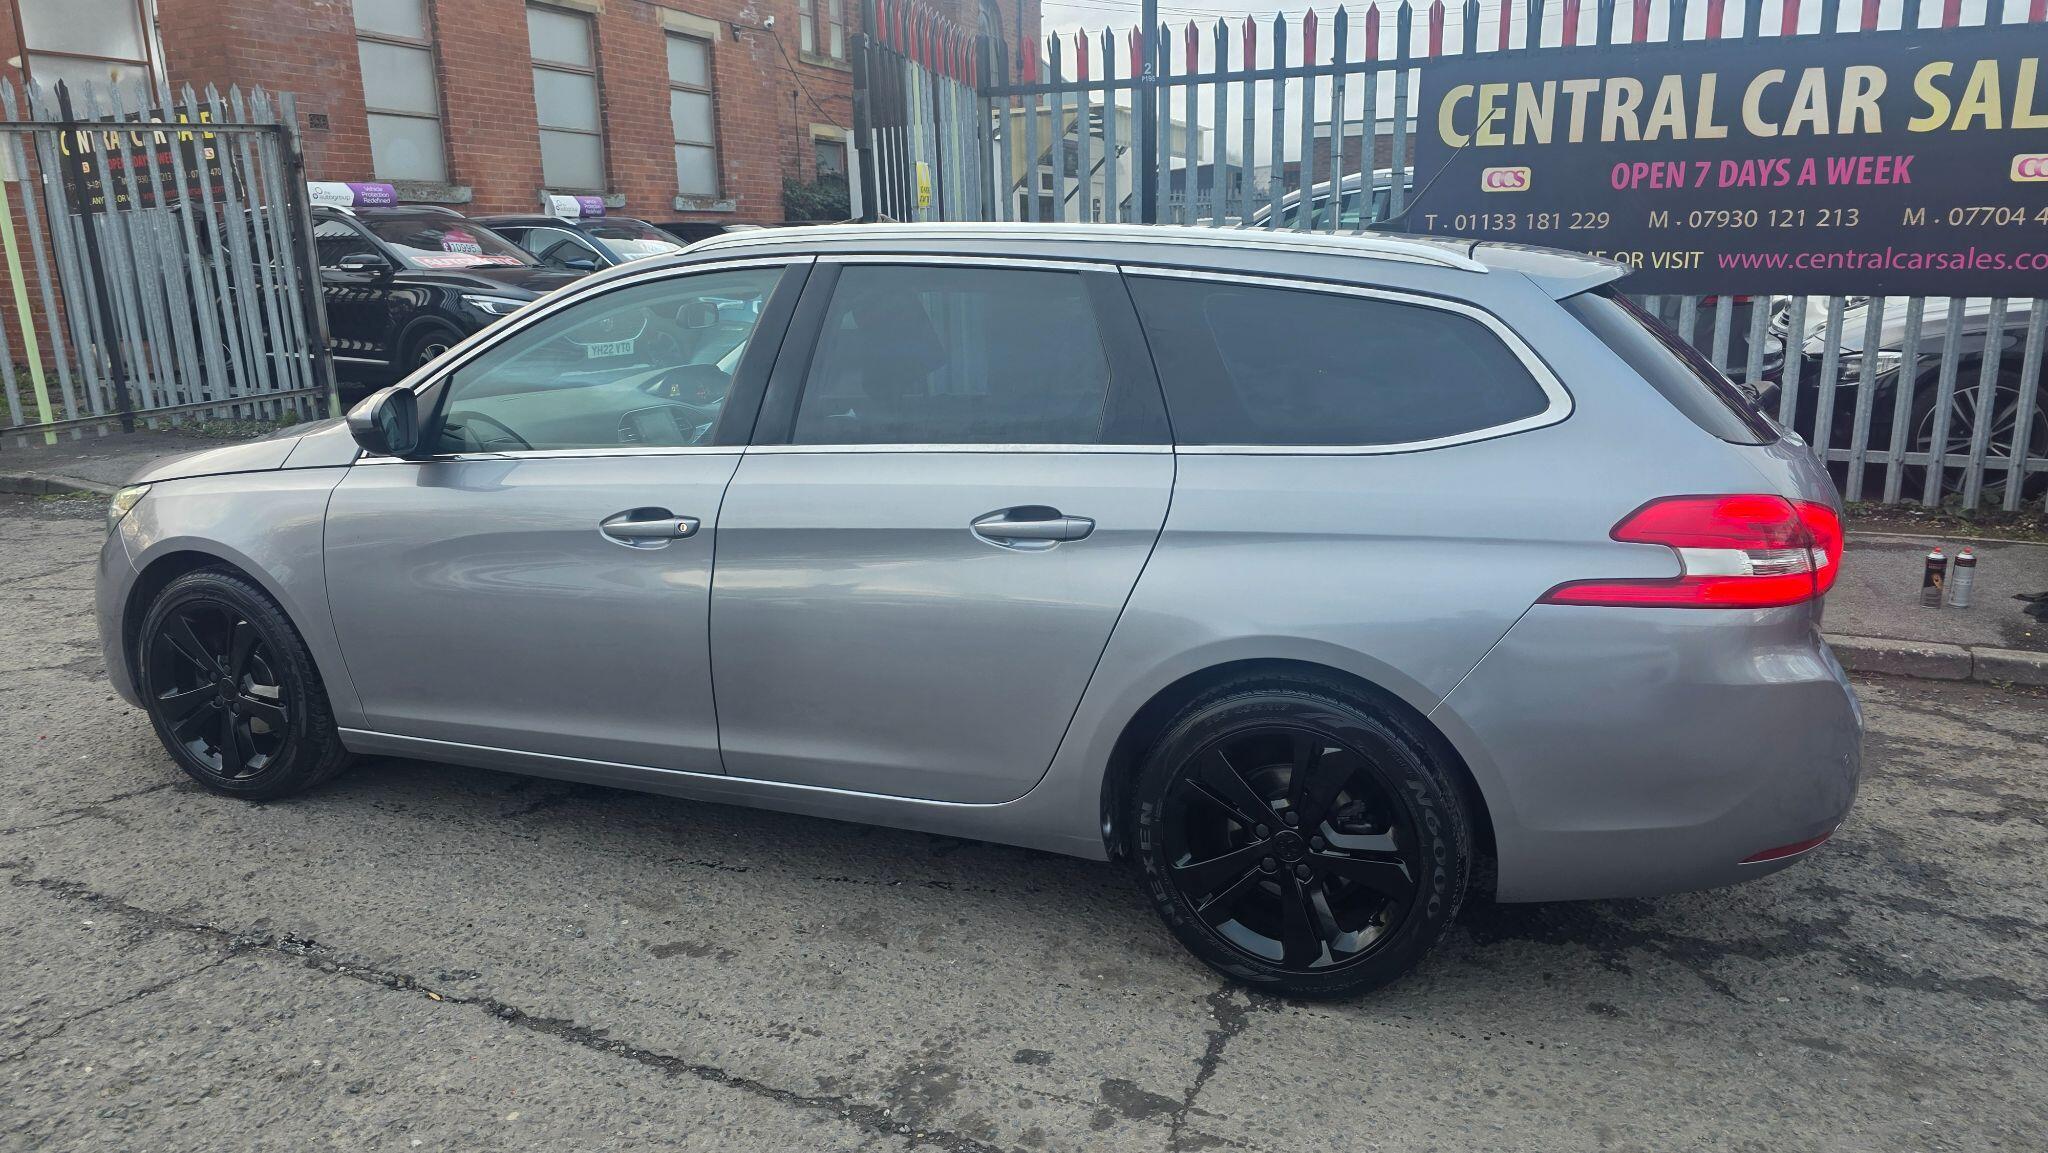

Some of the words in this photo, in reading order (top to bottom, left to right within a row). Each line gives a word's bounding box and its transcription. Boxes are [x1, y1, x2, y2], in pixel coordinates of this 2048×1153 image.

[1144, 62, 1152, 75] 2
[1438, 72, 1729, 148] CENTRAL
[1741, 65, 1888, 137] CAR
[1611, 160, 1687, 190] OPEN
[1694, 161, 1713, 188] 7
[1718, 158, 1792, 188] DAYS
[1797, 157, 1818, 187] A
[1827, 155, 1916, 186] WEEK
[2017, 157, 2048, 178] CC
[1487, 169, 1527, 189] CCS
[1455, 213, 1517, 231] 01133
[1527, 212, 1560, 230] 181
[1568, 211, 1610, 230] 229
[1688, 210, 1758, 228] 07930
[1769, 209, 1806, 228] 121
[1815, 208, 1860, 227] 213
[1948, 206, 2026, 226] 07704
[1613, 250, 1645, 269] OR
[1651, 250, 1705, 269] VISIT
